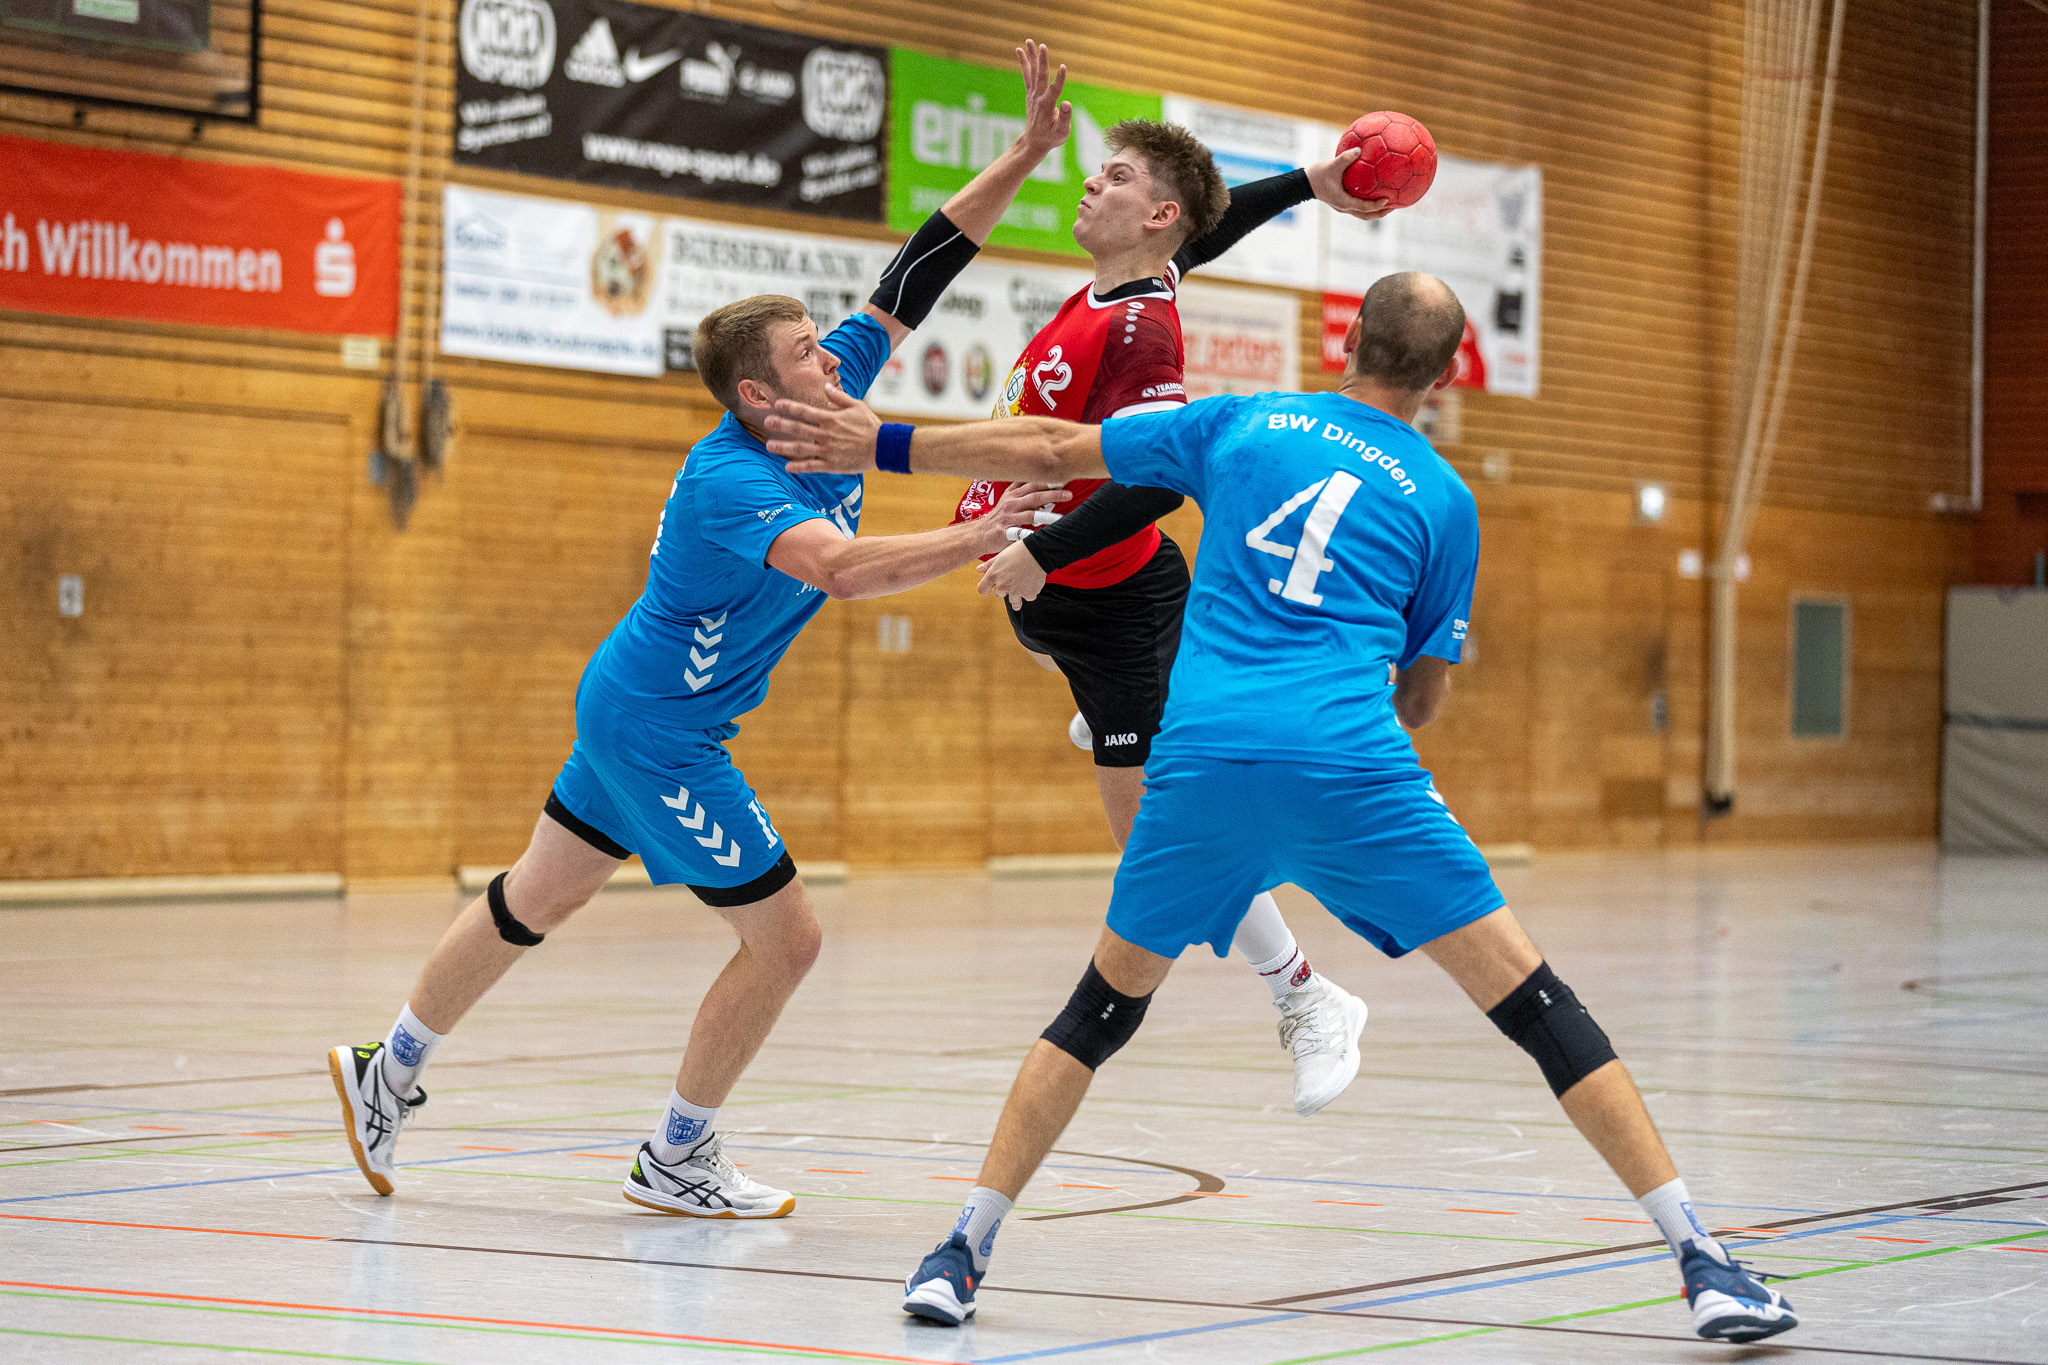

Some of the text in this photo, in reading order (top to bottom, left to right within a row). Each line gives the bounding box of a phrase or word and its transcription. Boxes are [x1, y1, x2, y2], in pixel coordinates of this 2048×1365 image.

[0, 212, 283, 294] h Willkommen
[1031, 344, 1073, 411] 22
[1268, 413, 1417, 496] BW Dingden
[1245, 470, 1363, 607] 4
[1104, 732, 1139, 747] JAKO
